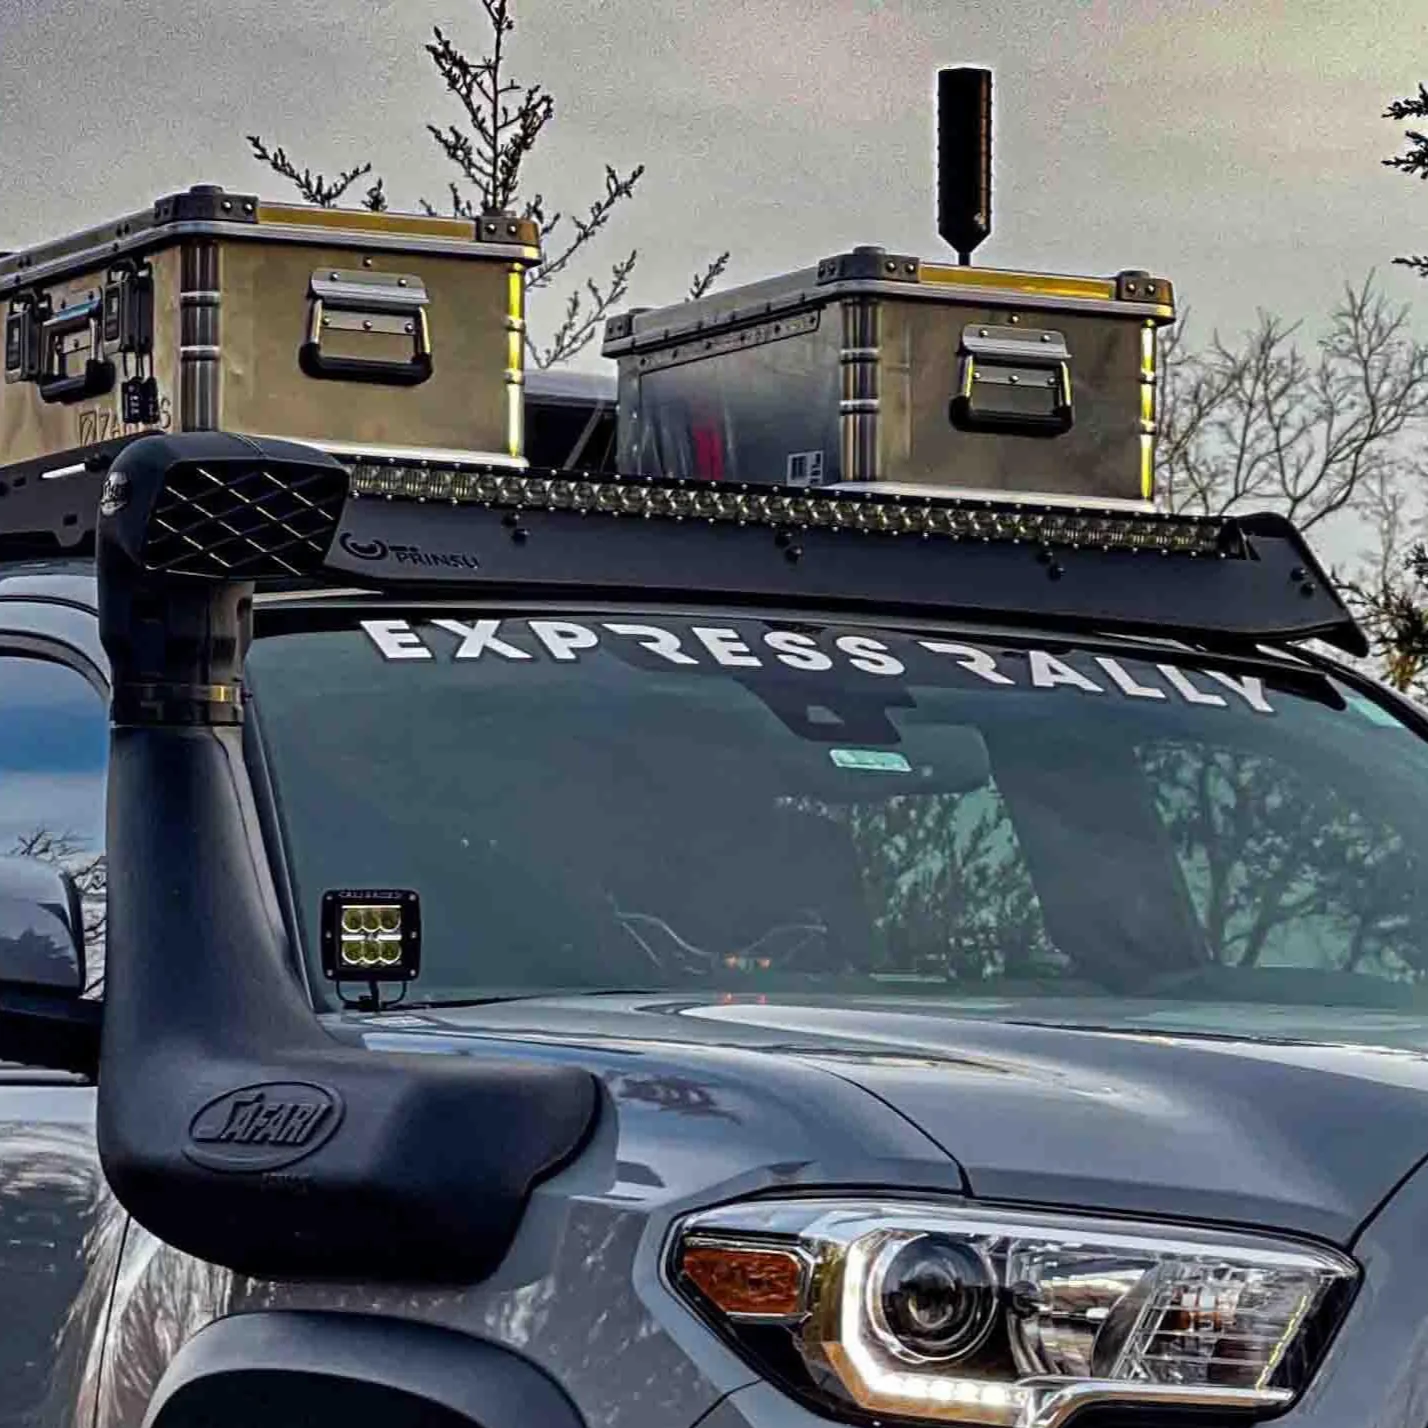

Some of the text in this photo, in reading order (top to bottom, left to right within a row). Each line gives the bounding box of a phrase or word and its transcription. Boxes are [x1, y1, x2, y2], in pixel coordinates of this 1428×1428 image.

[395, 551, 480, 569] PRINSU
[360, 619, 1275, 713] EXPRESS RALLY
[194, 1092, 333, 1147] SAFARI
